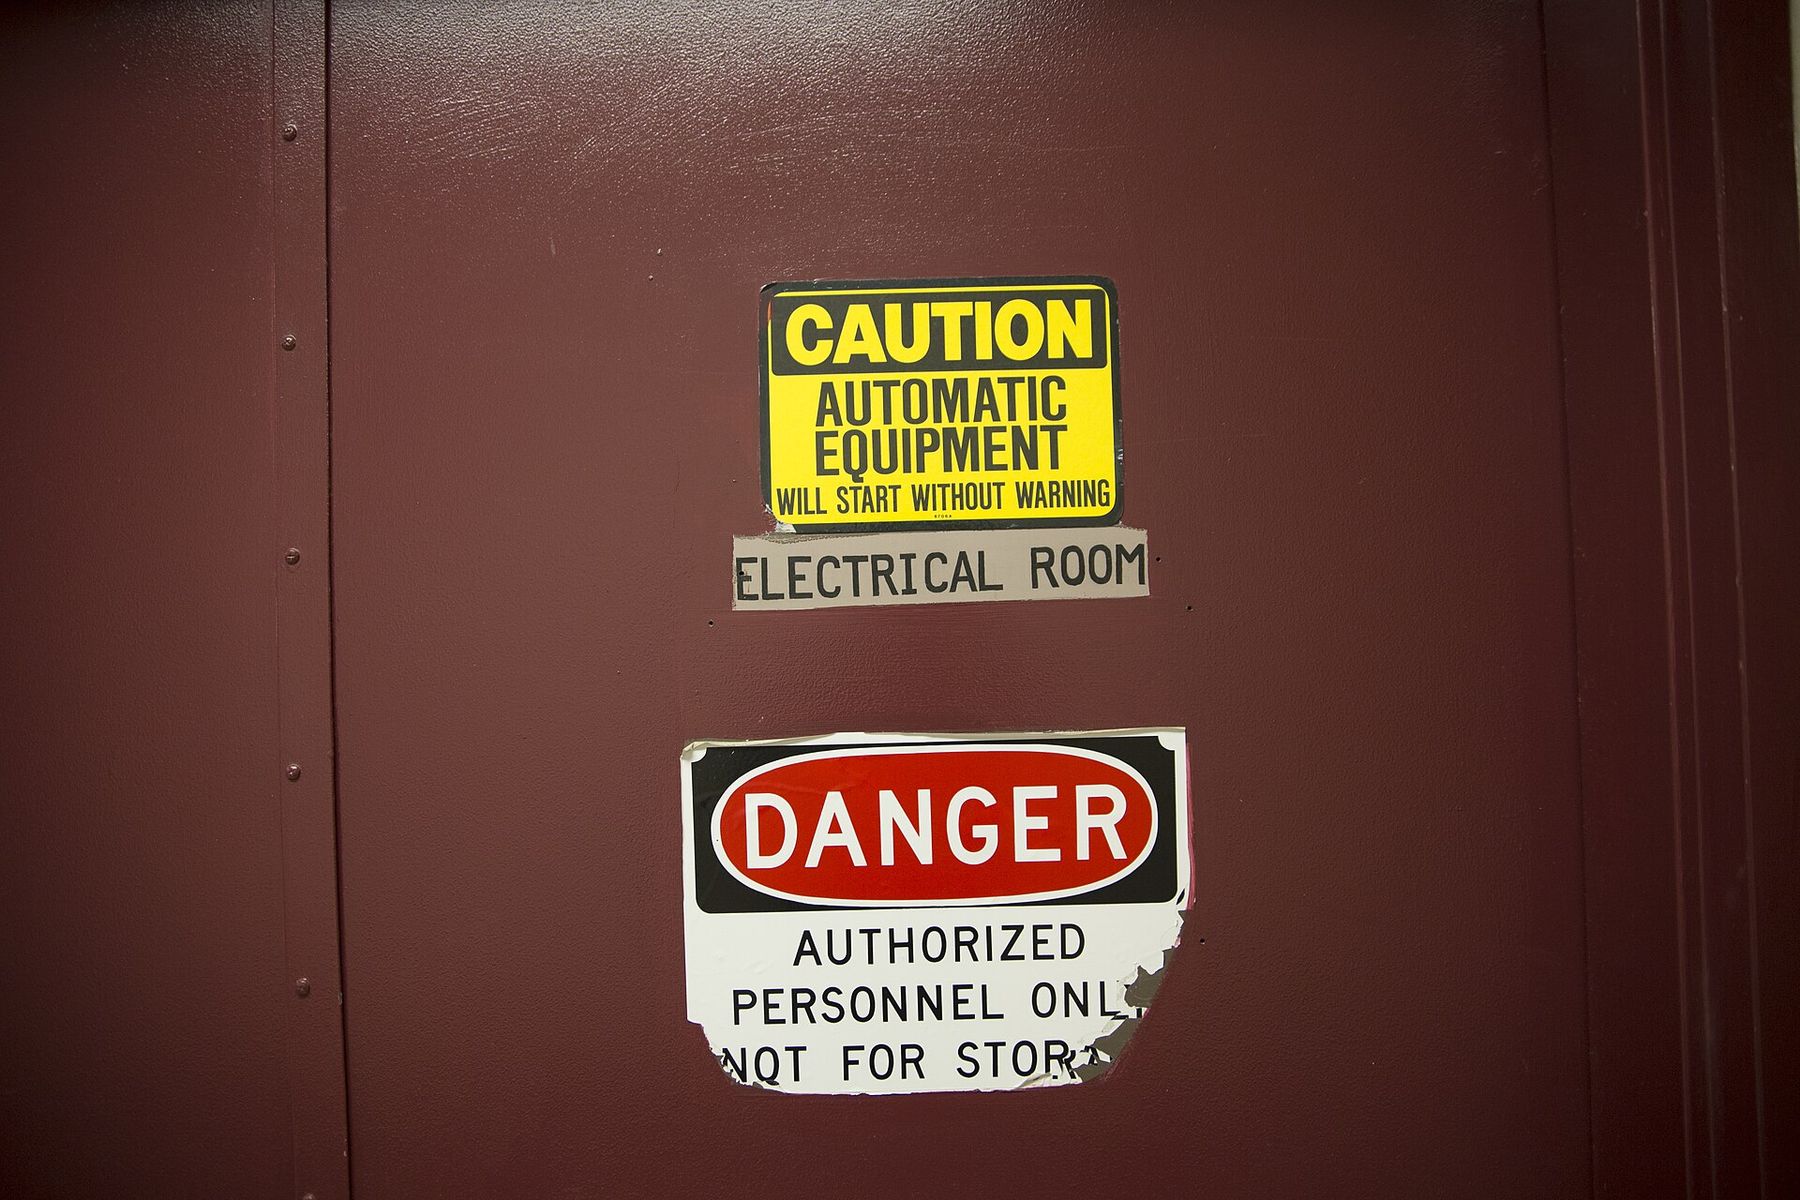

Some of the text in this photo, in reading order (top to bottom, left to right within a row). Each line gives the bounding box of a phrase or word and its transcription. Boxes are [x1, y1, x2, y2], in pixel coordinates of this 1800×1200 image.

[785, 298, 1093, 367] CAUTION
[815, 375, 1067, 427] AUTOMATIC
[815, 424, 1069, 483] EQUIPMENT
[777, 479, 1111, 516] WILL START WITHOUT WARNING
[735, 543, 1146, 601] ELECTRICAL ROOM
[744, 784, 1128, 870] DANGER
[793, 923, 1086, 967] AUTHORIZED
[733, 981, 1142, 1026] PERSONNEL ONL
[722, 1046, 807, 1085] NOT
[842, 1043, 926, 1081] FOR
